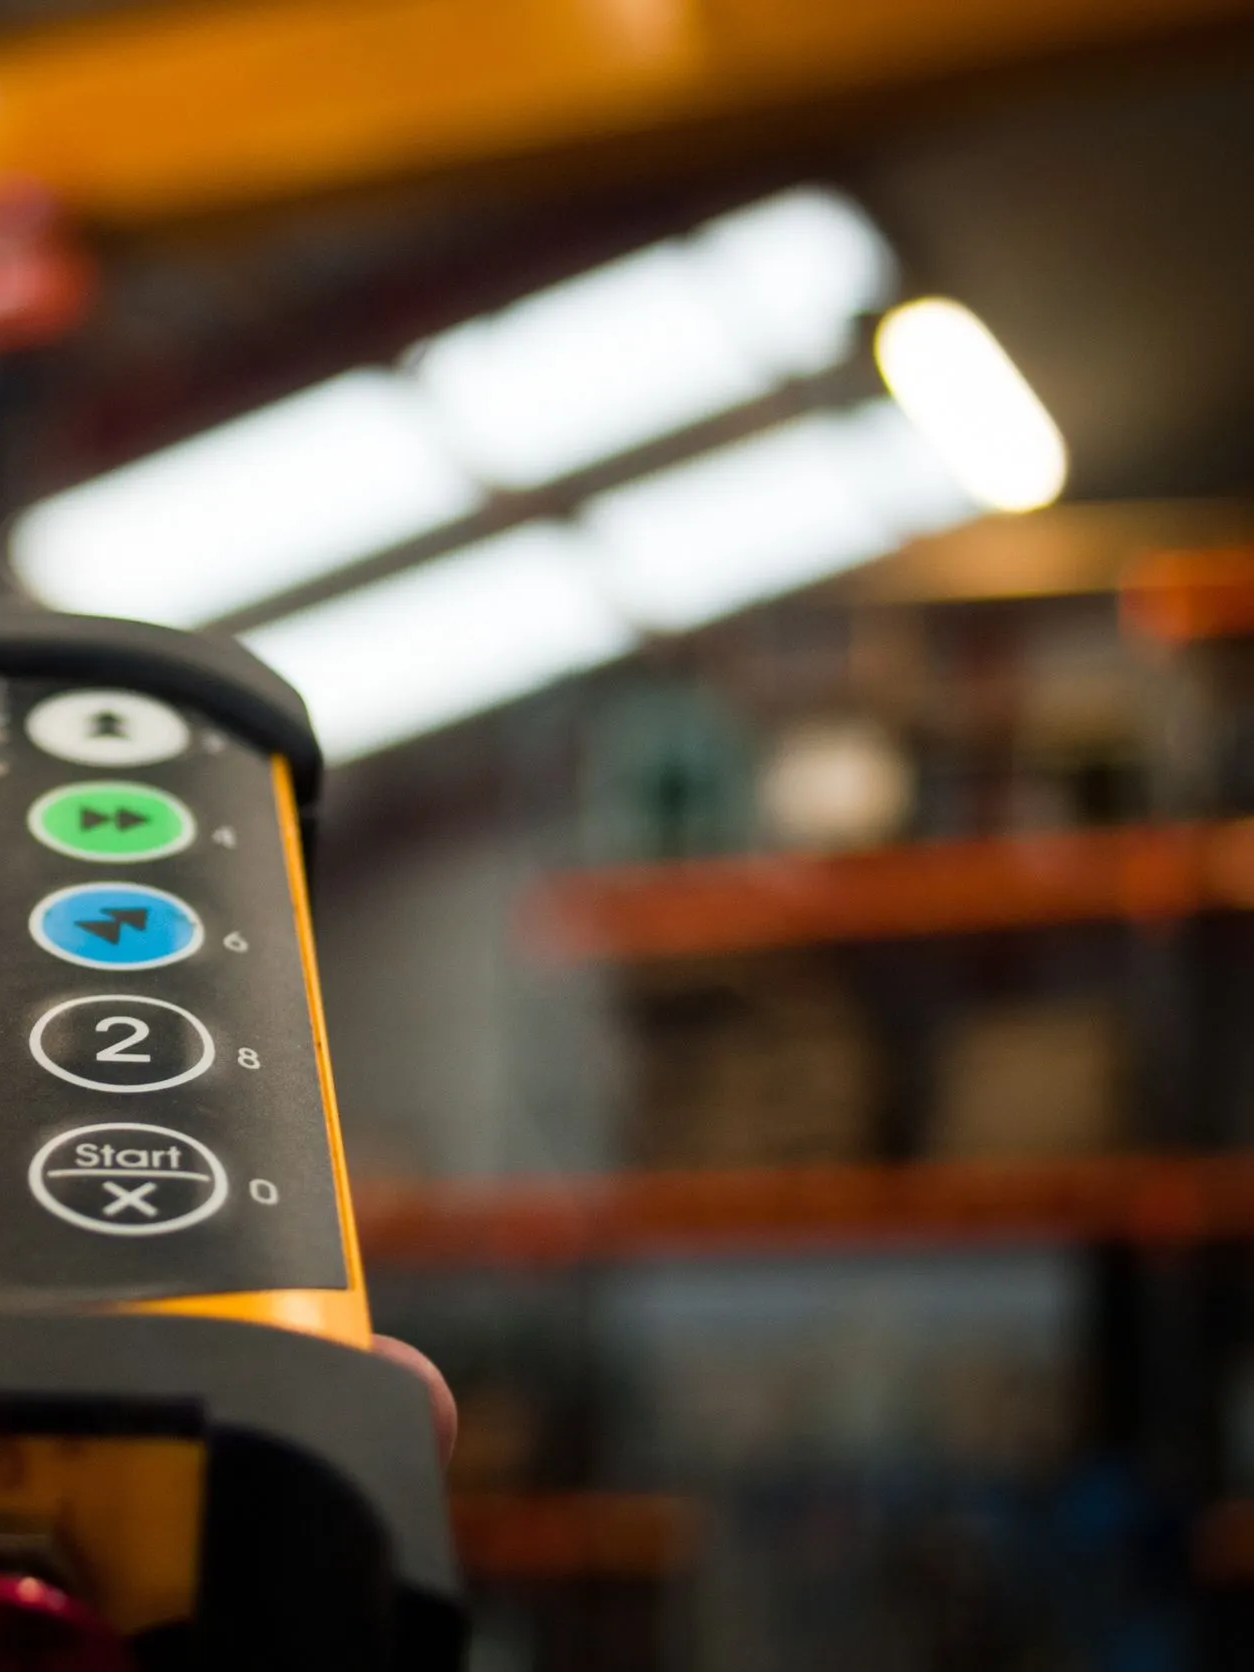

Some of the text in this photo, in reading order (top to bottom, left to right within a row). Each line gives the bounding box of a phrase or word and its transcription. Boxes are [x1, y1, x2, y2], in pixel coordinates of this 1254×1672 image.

[222, 931, 248, 953] 6
[95, 1016, 151, 1063] 2
[237, 1047, 261, 1069] 8
[74, 1142, 181, 1170] Start
